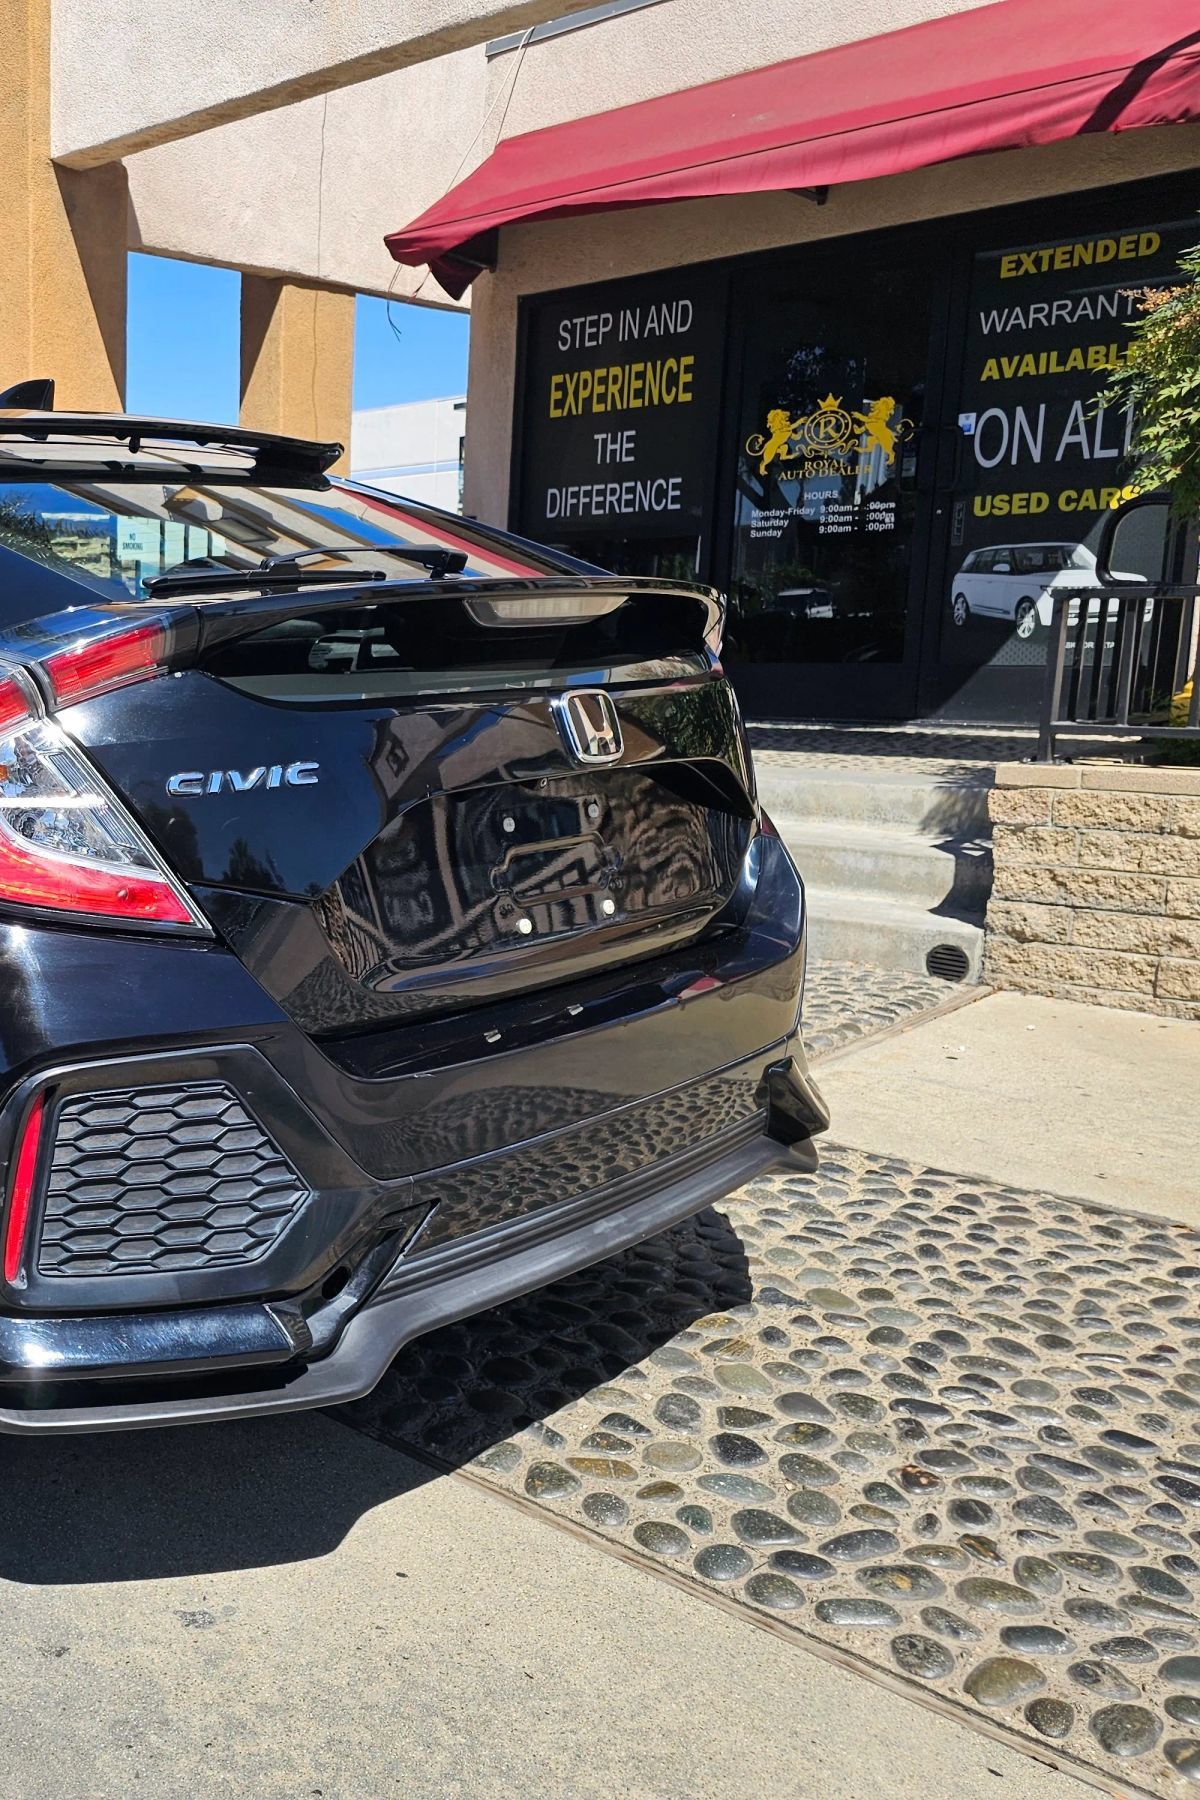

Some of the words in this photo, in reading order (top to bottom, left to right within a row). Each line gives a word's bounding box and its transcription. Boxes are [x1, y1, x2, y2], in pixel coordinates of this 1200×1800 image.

[1000, 231, 1161, 279] EXTENDED
[558, 312, 613, 351] STEP
[619, 307, 640, 342] IN
[644, 299, 693, 338] AND
[980, 294, 1137, 334] WARRANT
[549, 355, 695, 418] EXPERIENCE
[594, 430, 636, 464] THE
[974, 403, 1046, 468] ON
[778, 468, 816, 481] AUTO
[819, 464, 873, 478] DEALER
[803, 459, 849, 472] ROYAL
[546, 477, 682, 518] DIFFERENCE
[804, 490, 839, 500] HOURS
[973, 491, 1050, 517] USED
[751, 507, 815, 518] Monday-Friday
[820, 504, 853, 513] 9:00am
[751, 518, 789, 528] Saturday
[820, 514, 853, 523] 9:00am
[750, 529, 782, 538] Sunday
[818, 524, 852, 534] 9:00am
[122, 542, 144, 551] SMOKING
[167, 760, 320, 797] CIVIC
